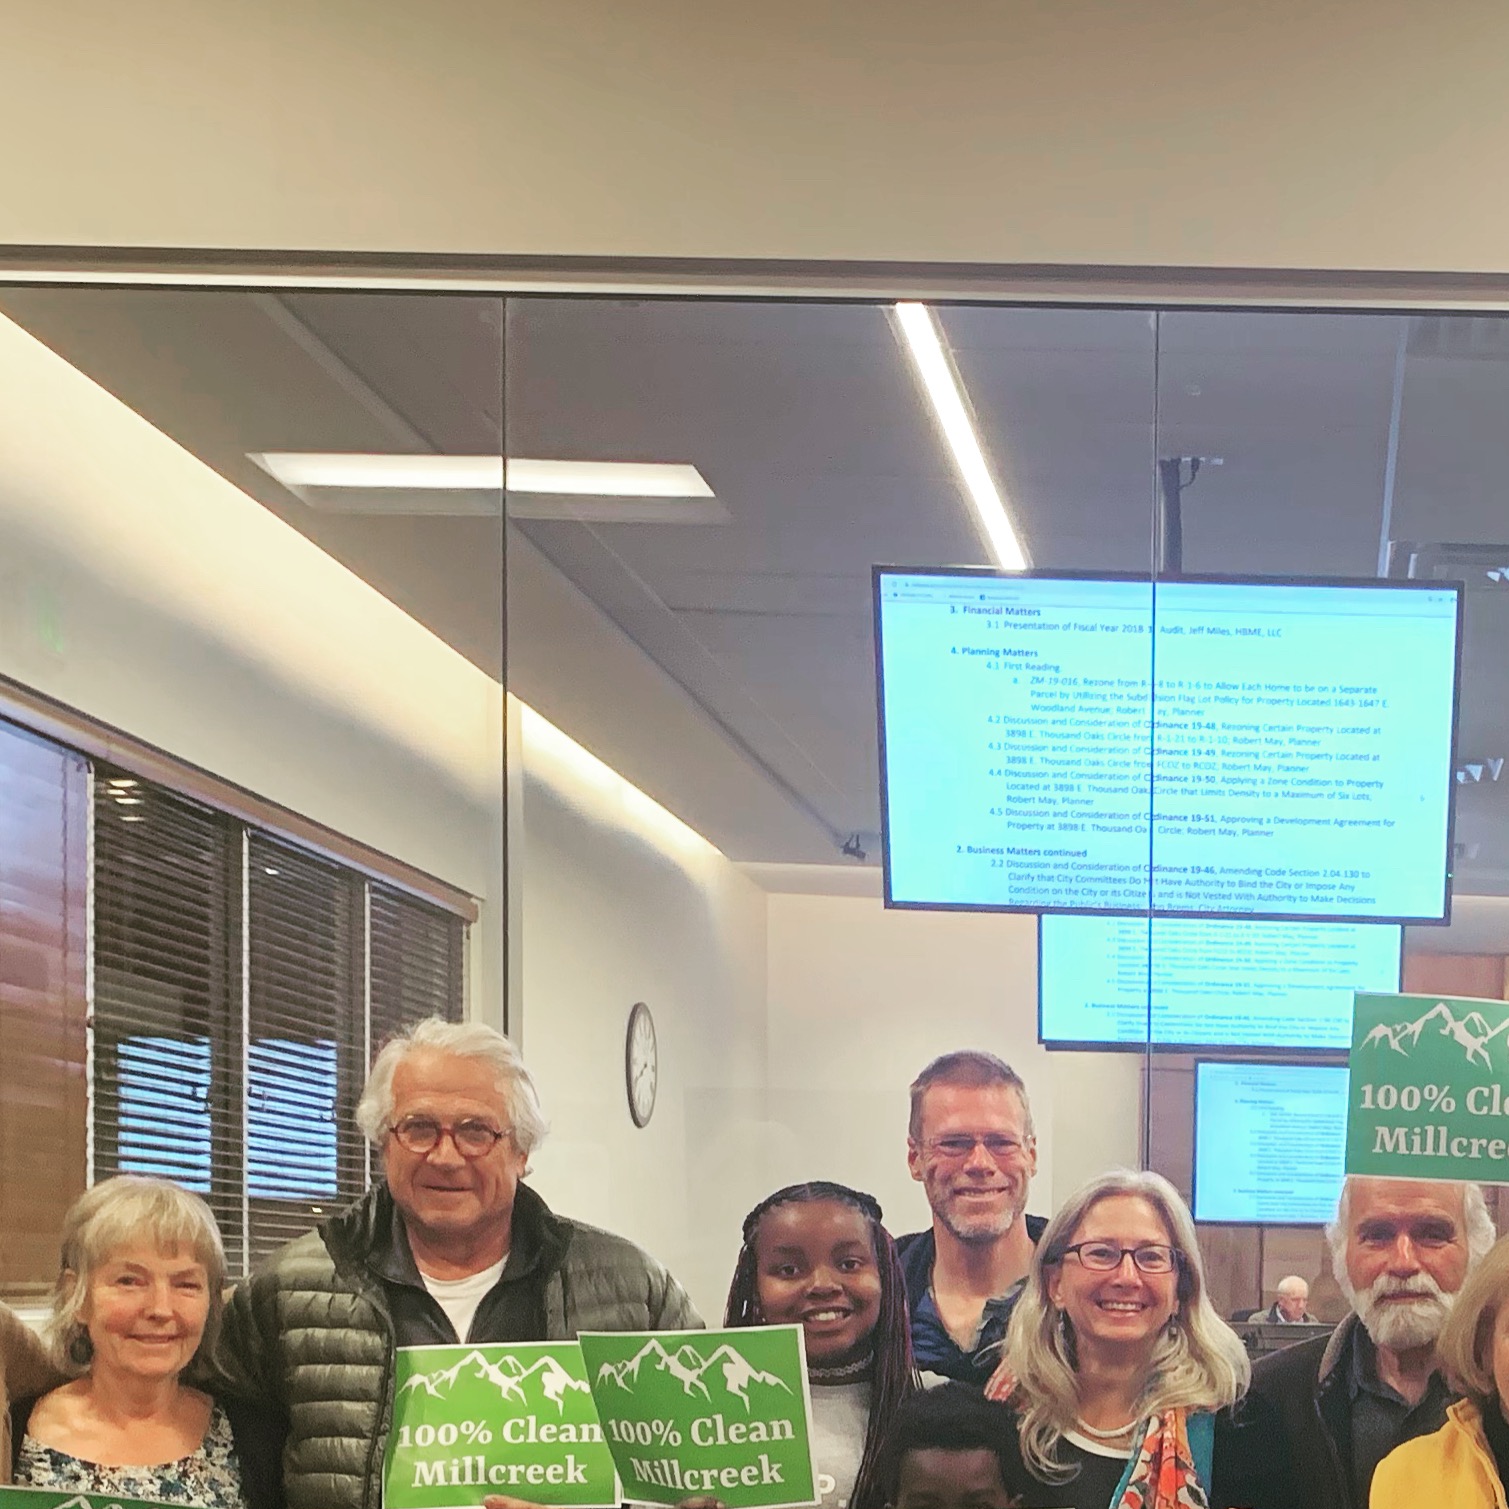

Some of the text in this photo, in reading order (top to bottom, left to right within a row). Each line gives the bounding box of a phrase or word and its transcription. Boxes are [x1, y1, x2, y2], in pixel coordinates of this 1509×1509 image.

[1360, 1084, 1456, 1113] 100%
[397, 1415, 603, 1448] 100% Clean
[608, 1414, 795, 1447] 100% Clean
[411, 1455, 589, 1488] Millcreek
[630, 1455, 785, 1490] Millcreek
